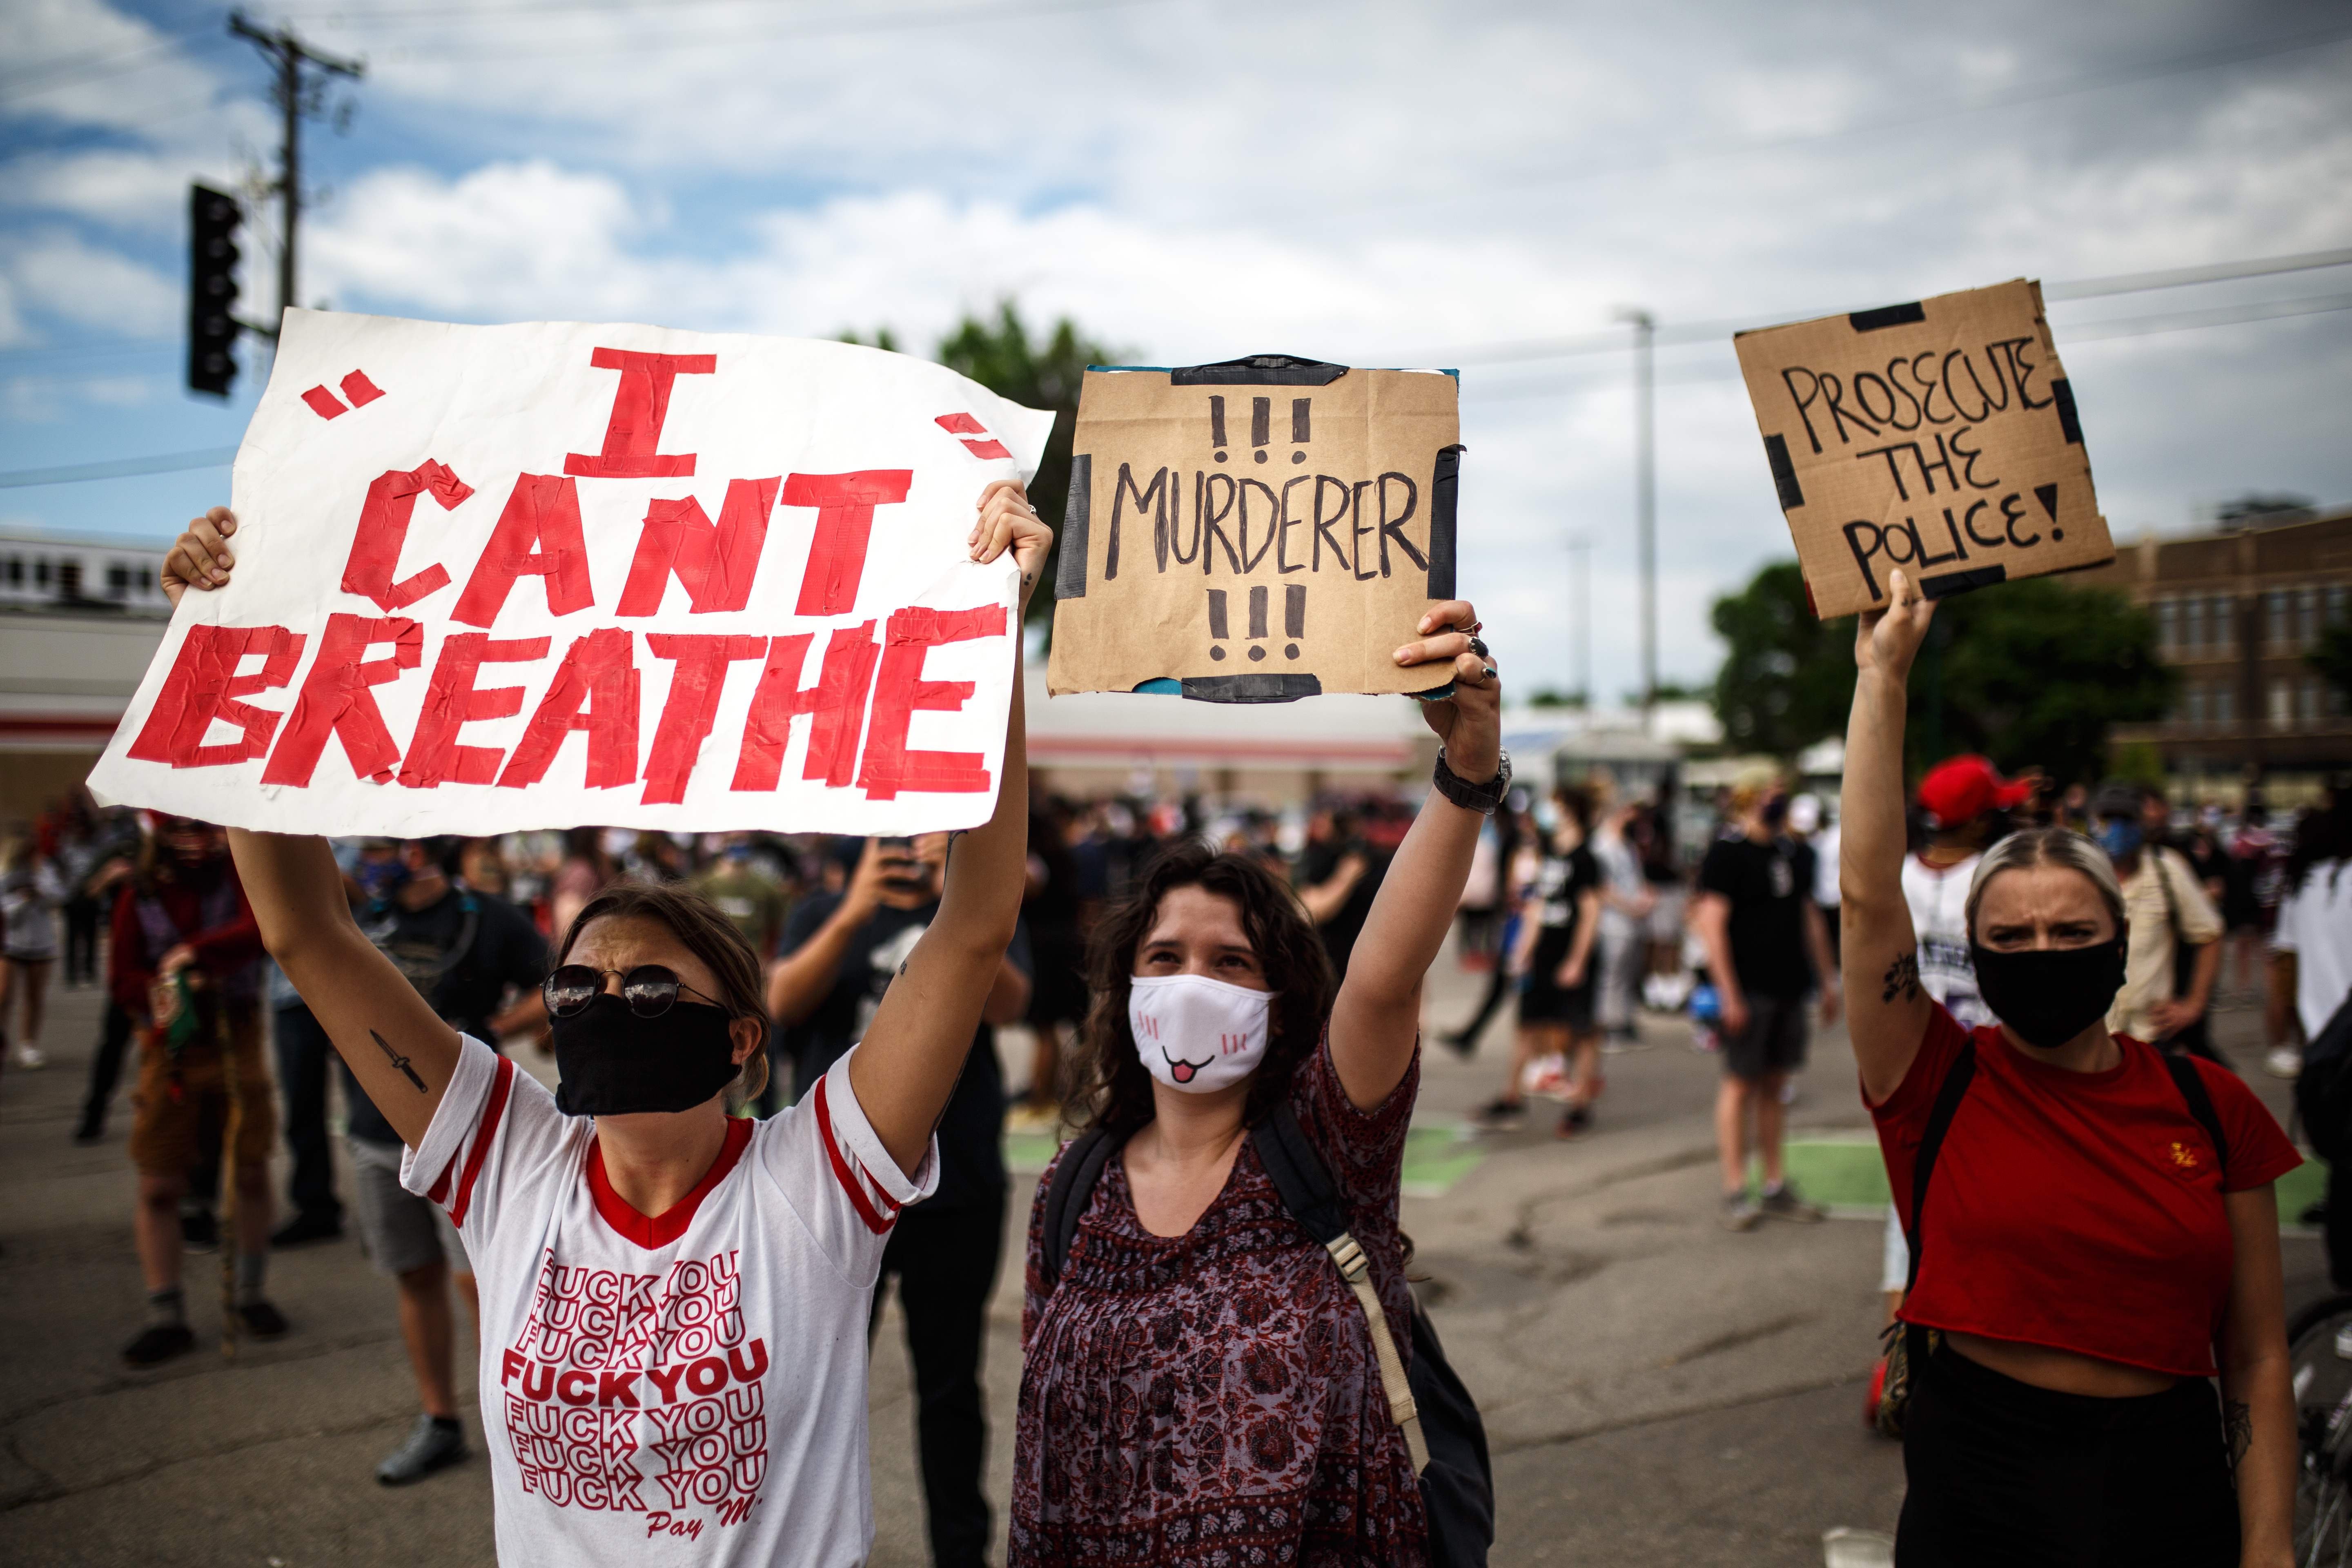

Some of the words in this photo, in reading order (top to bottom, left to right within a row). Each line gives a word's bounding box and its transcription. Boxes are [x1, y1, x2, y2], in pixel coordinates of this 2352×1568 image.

[563, 347, 717, 479] I
[1781, 335, 2054, 454] PROSECUTE
[1855, 426, 2000, 502] THE
[341, 458, 913, 629] CANT
[1104, 462, 1429, 581] MURDERER
[1842, 481, 2065, 602] POLICE!
[127, 602, 1008, 806] BREATHE
[514, 1318, 650, 1370] FUCK
[648, 1306, 746, 1368] YOU
[655, 1272, 741, 1332] YOU
[501, 1348, 643, 1408] FUCK
[645, 1337, 768, 1405] YOU
[504, 1391, 640, 1448] FUCK
[644, 1380, 764, 1442] YOU
[509, 1430, 644, 1480] FUCK
[648, 1414, 766, 1473] YOU
[519, 1463, 649, 1511] FUCK
[654, 1449, 768, 1510] YOU
[646, 1511, 704, 1542] Pay
[716, 1493, 763, 1528] M
